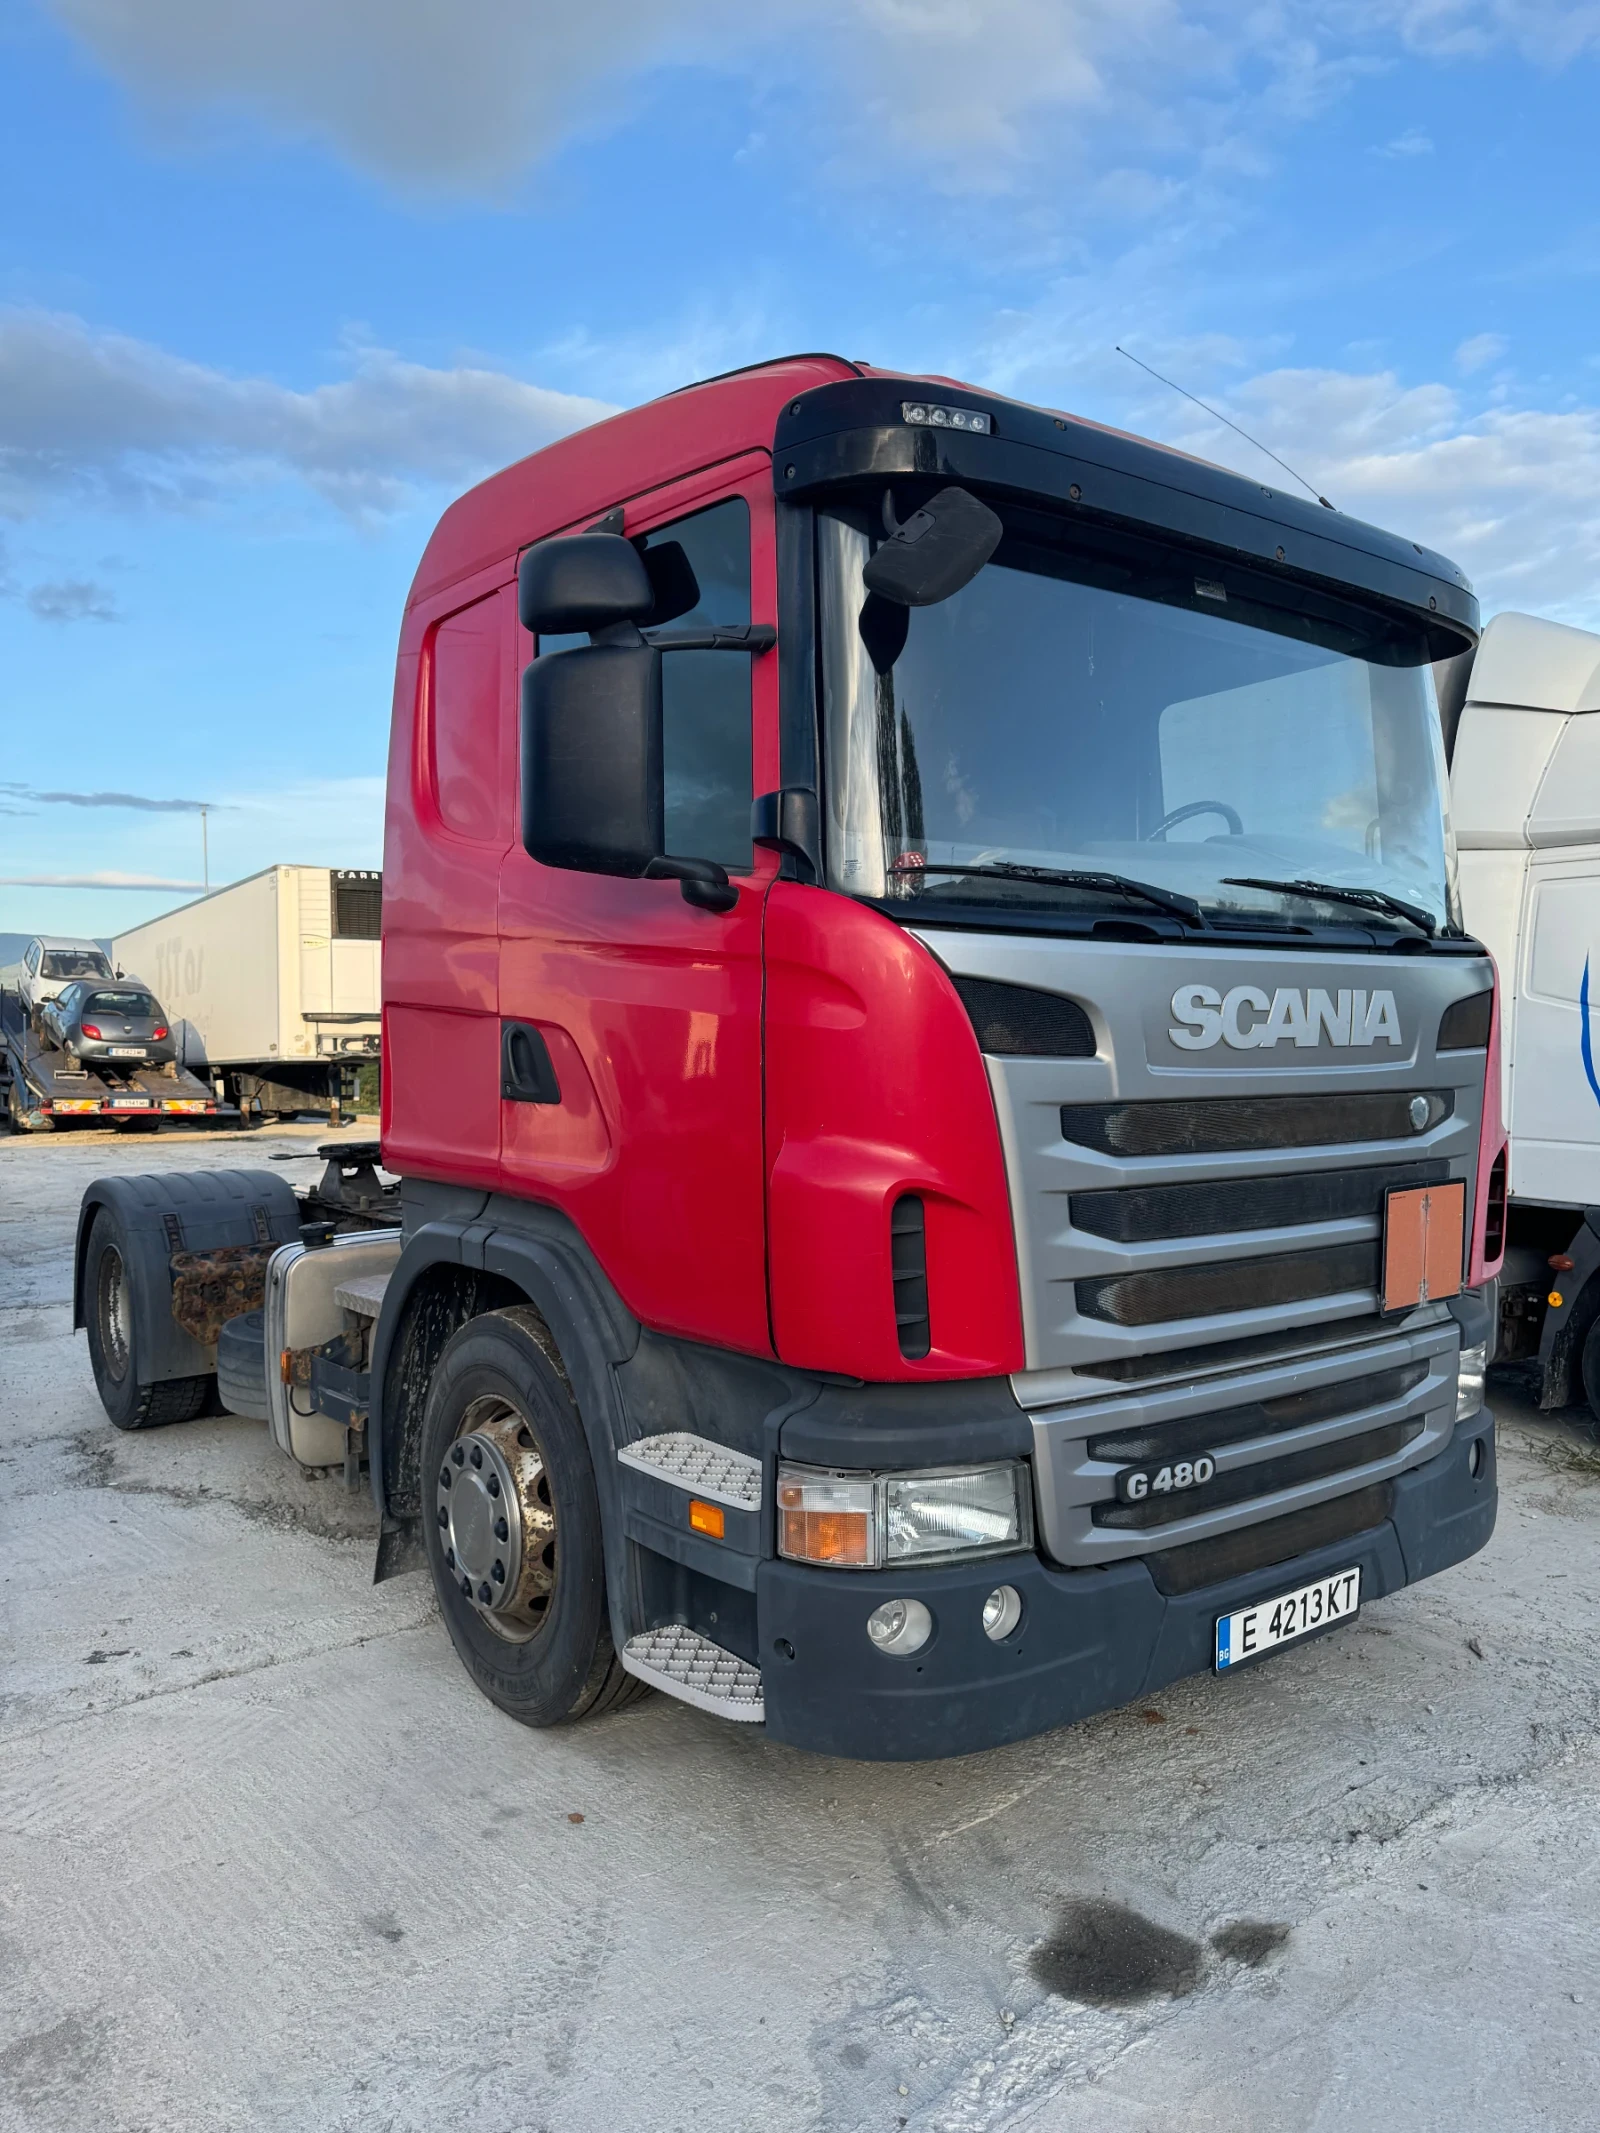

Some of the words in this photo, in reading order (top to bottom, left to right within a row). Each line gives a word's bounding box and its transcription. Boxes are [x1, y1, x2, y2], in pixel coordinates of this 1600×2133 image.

[337, 871, 379, 880] CARR
[1168, 984, 1403, 1050] SCANIA
[1242, 1612, 1258, 1654] E
[1219, 1647, 1229, 1662] BG
